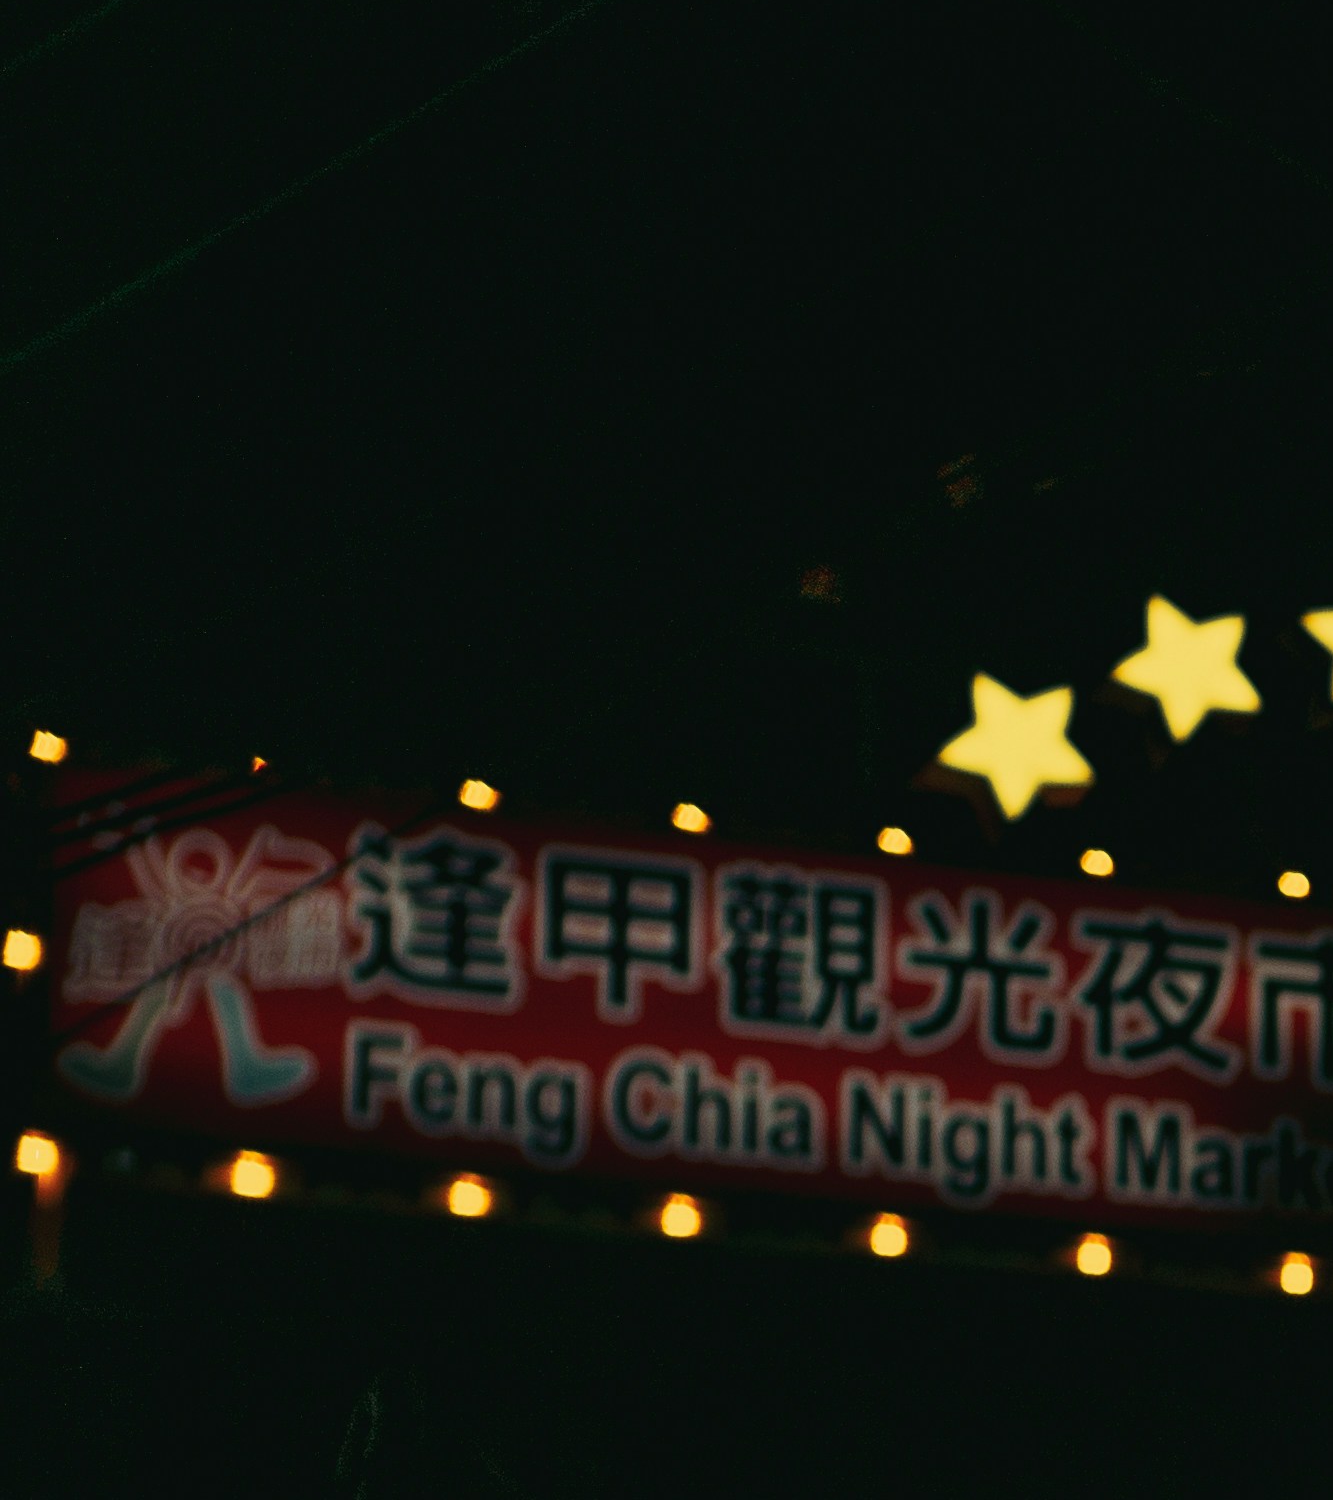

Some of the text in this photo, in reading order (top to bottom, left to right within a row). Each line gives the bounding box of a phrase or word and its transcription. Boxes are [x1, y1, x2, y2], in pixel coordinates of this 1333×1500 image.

[346, 1020, 592, 1168] Feng
[607, 1045, 826, 1172] Chia
[840, 1066, 1098, 1207] Night
